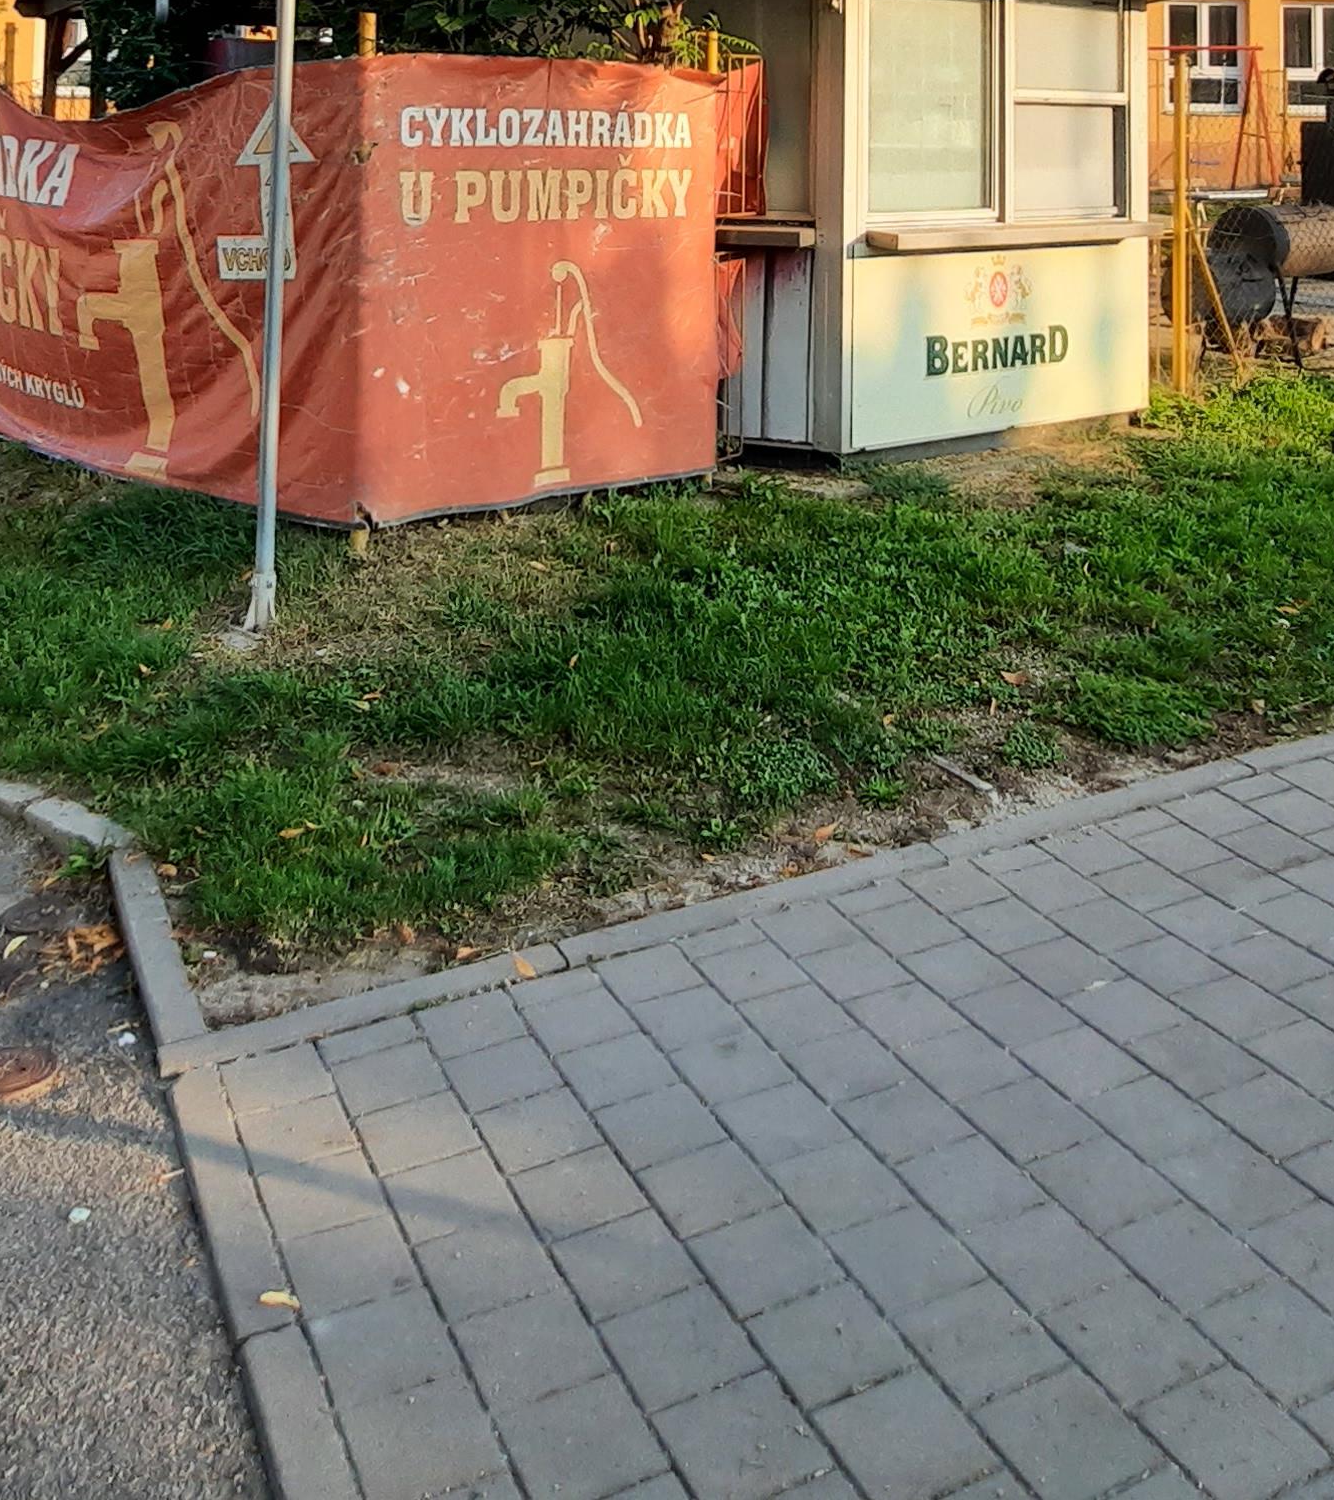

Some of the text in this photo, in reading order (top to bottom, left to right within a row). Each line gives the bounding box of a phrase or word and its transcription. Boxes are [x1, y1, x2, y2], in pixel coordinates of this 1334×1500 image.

[400, 100, 693, 149] CYKLOZAHRÁDKA
[399, 153, 693, 226] U PUMPIČKY
[222, 247, 292, 272] VCH
[925, 324, 1069, 377] BERNARD
[24, 372, 85, 409] KRÝGLŮ
[967, 377, 1024, 419] Pivo
